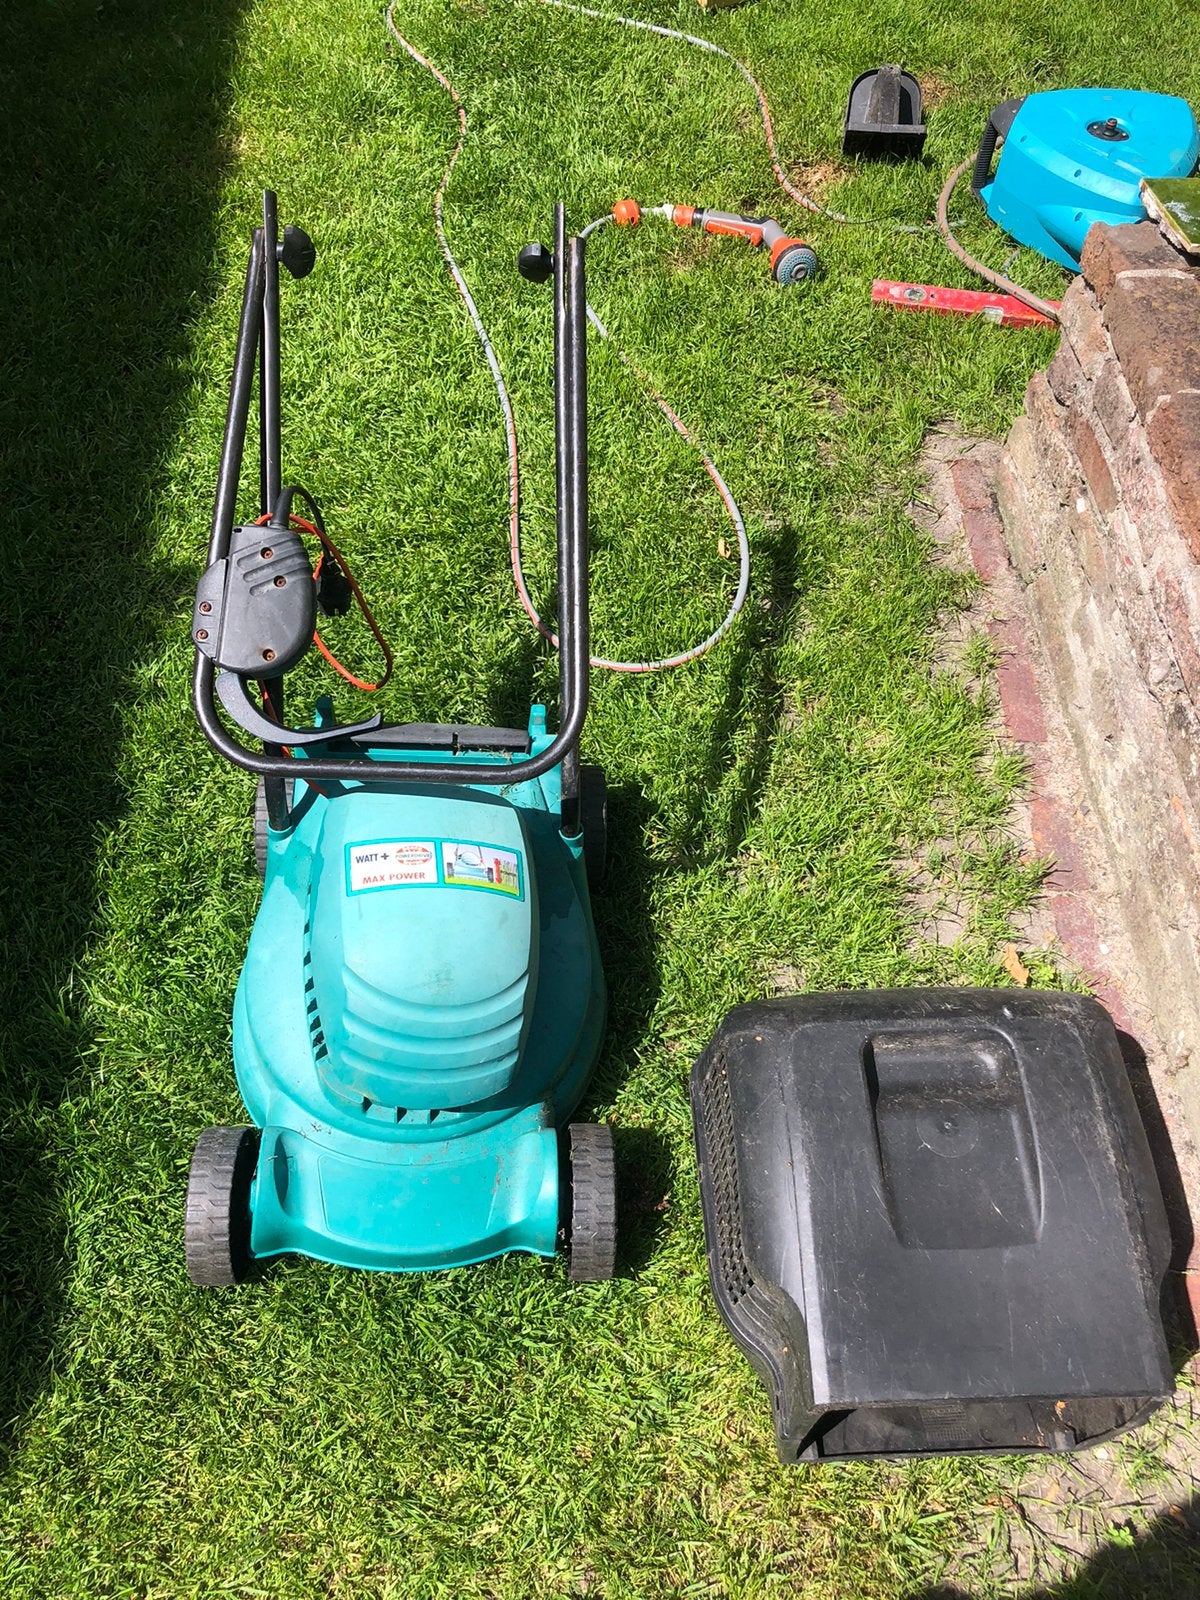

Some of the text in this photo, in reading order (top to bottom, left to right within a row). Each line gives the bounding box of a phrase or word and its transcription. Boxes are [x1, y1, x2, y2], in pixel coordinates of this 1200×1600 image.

[355, 853, 378, 864] WATT
[362, 872, 426, 885] MAX POWER
